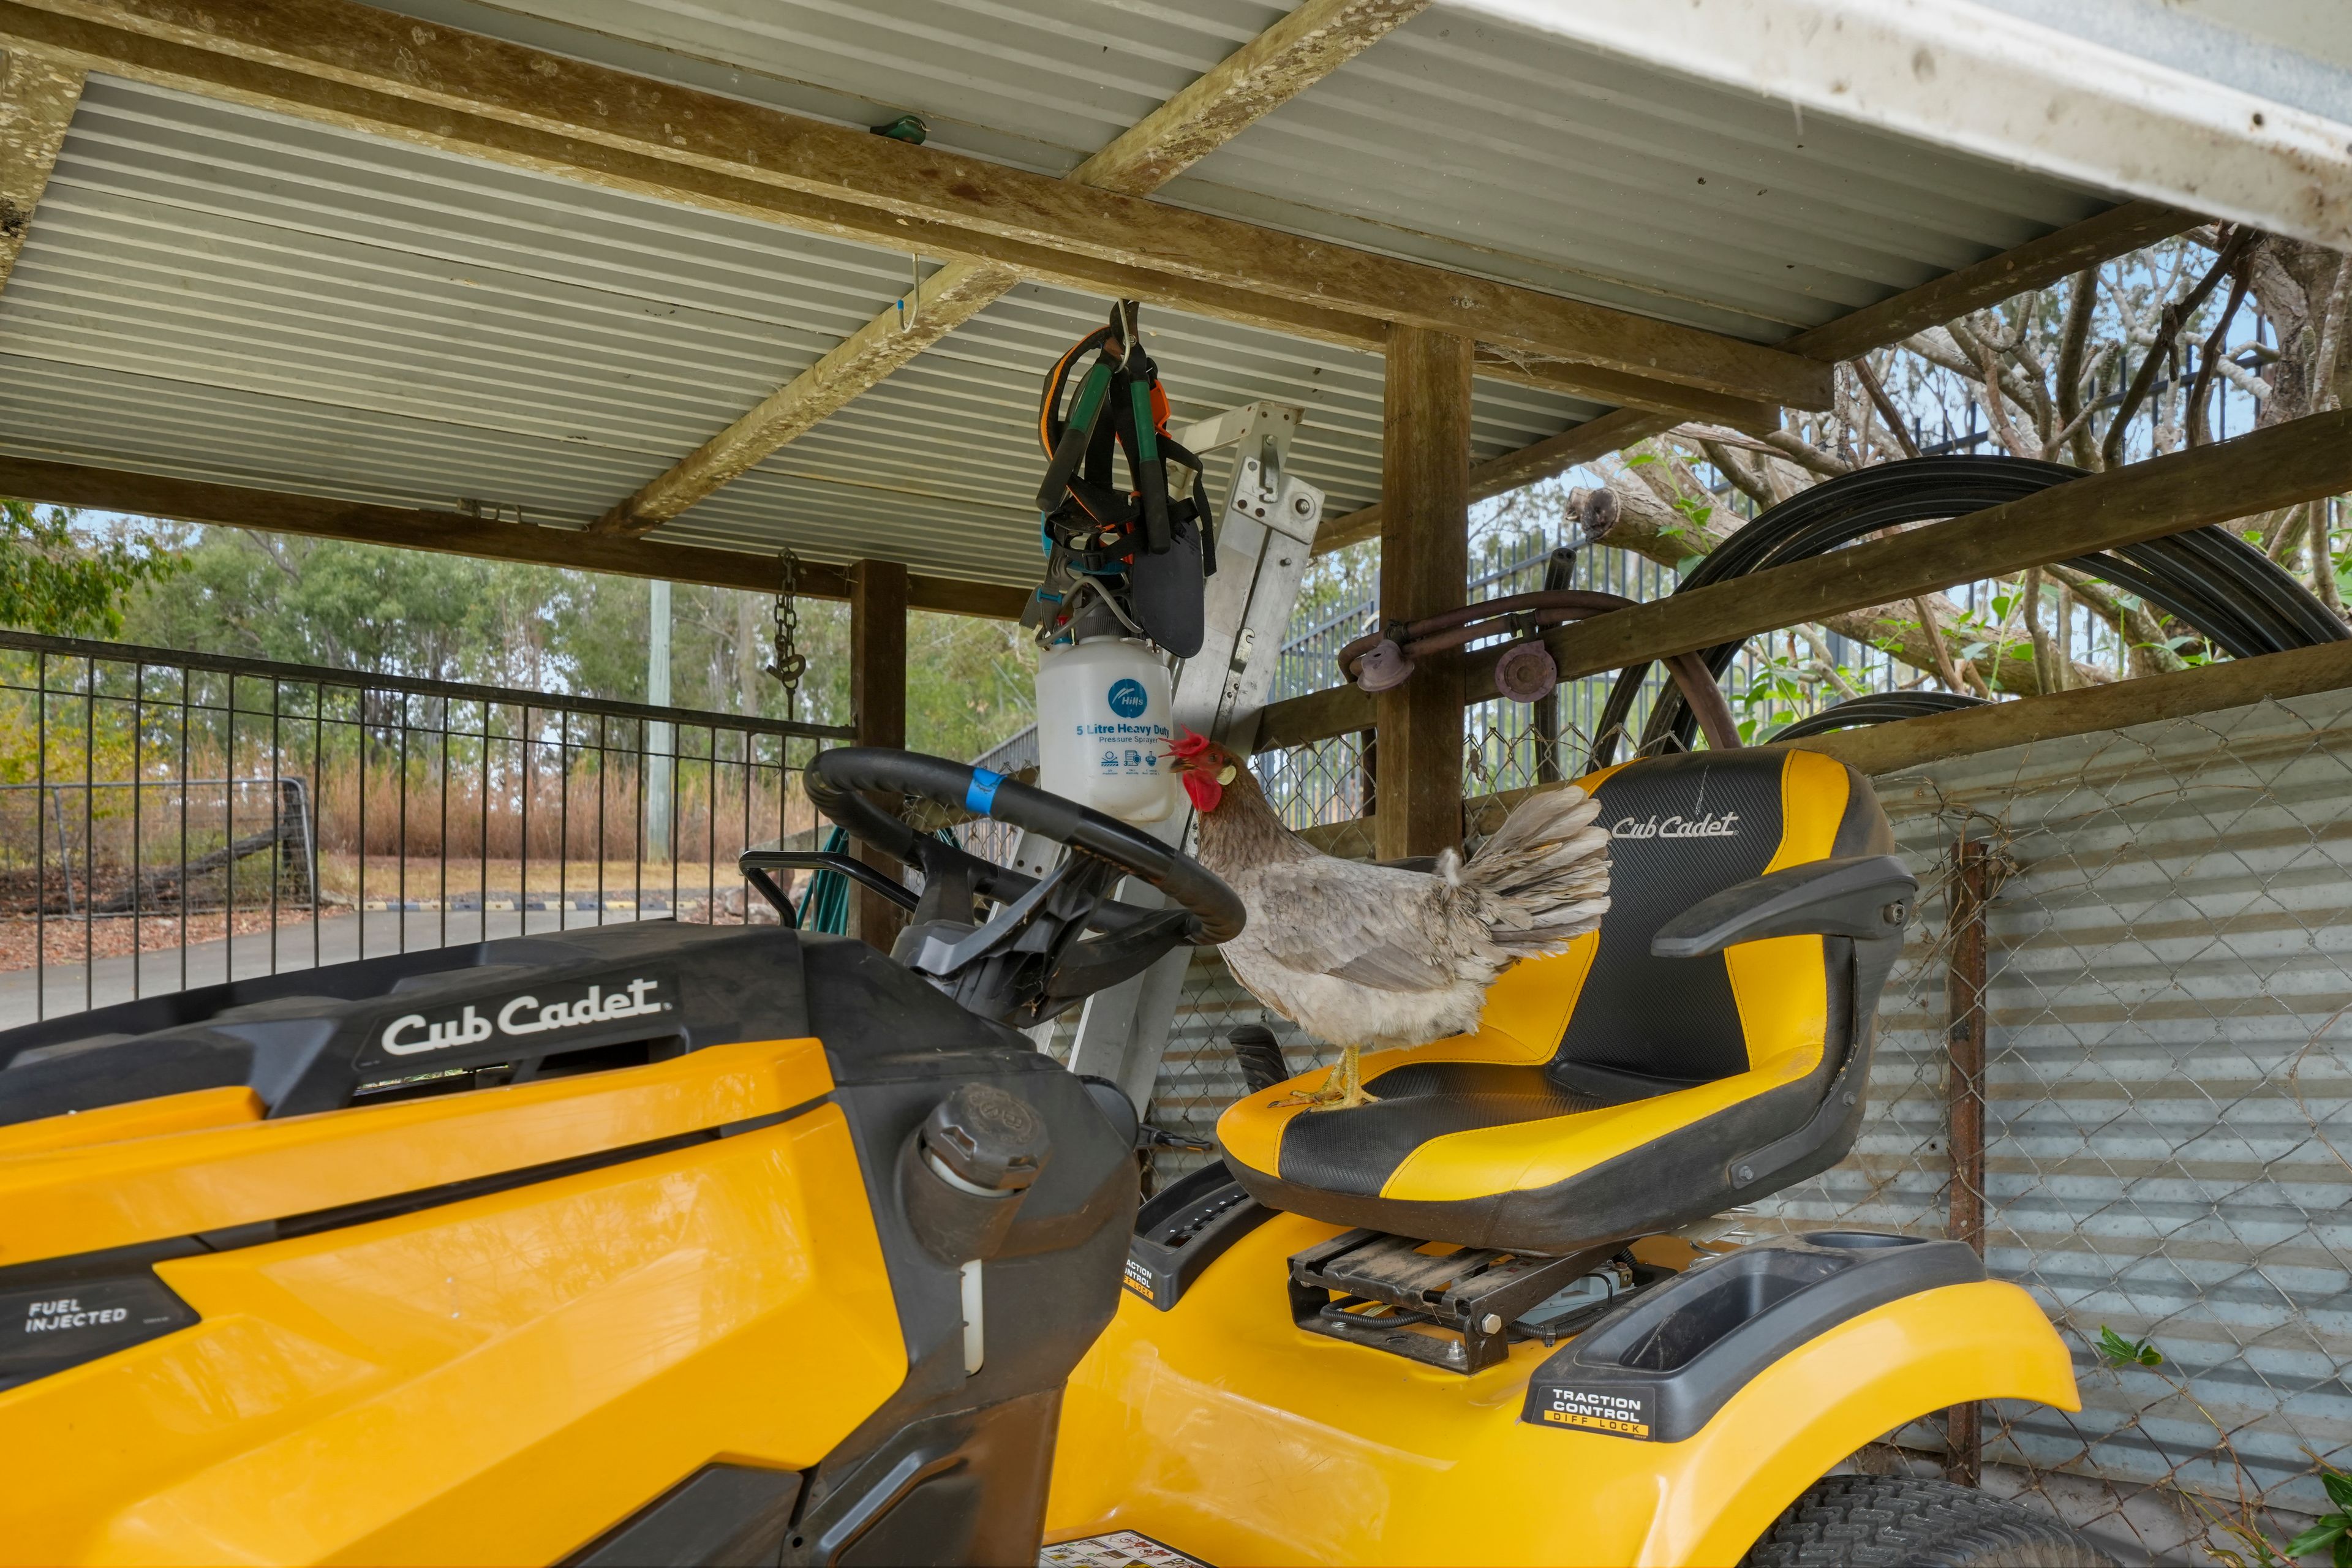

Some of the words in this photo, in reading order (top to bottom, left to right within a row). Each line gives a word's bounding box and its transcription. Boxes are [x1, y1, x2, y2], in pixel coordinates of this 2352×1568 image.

[1121, 696, 1144, 706] Hills
[1077, 725, 1083, 735] 5
[1087, 724, 1114, 734] Litre
[1118, 724, 1151, 736] Heavy
[1154, 725, 1169, 739] Duty
[1134, 736, 1158, 744] Sprayer
[1611, 815, 1656, 839] Cub
[1659, 812, 1740, 838] Cadet
[382, 1006, 492, 1056] Cub
[497, 978, 663, 1035] Cadet
[1125, 1267, 1150, 1288] NTROL
[1126, 1259, 1152, 1280] ACTION
[1134, 1283, 1150, 1297] LOCK
[28, 1298, 81, 1317] FUEL
[25, 1308, 127, 1333] INJECTED
[1553, 1389, 1641, 1410] TRACTION
[1553, 1401, 1640, 1422] CONTROL
[1554, 1412, 1588, 1424] DIFF
[1600, 1420, 1639, 1433] LOCK
